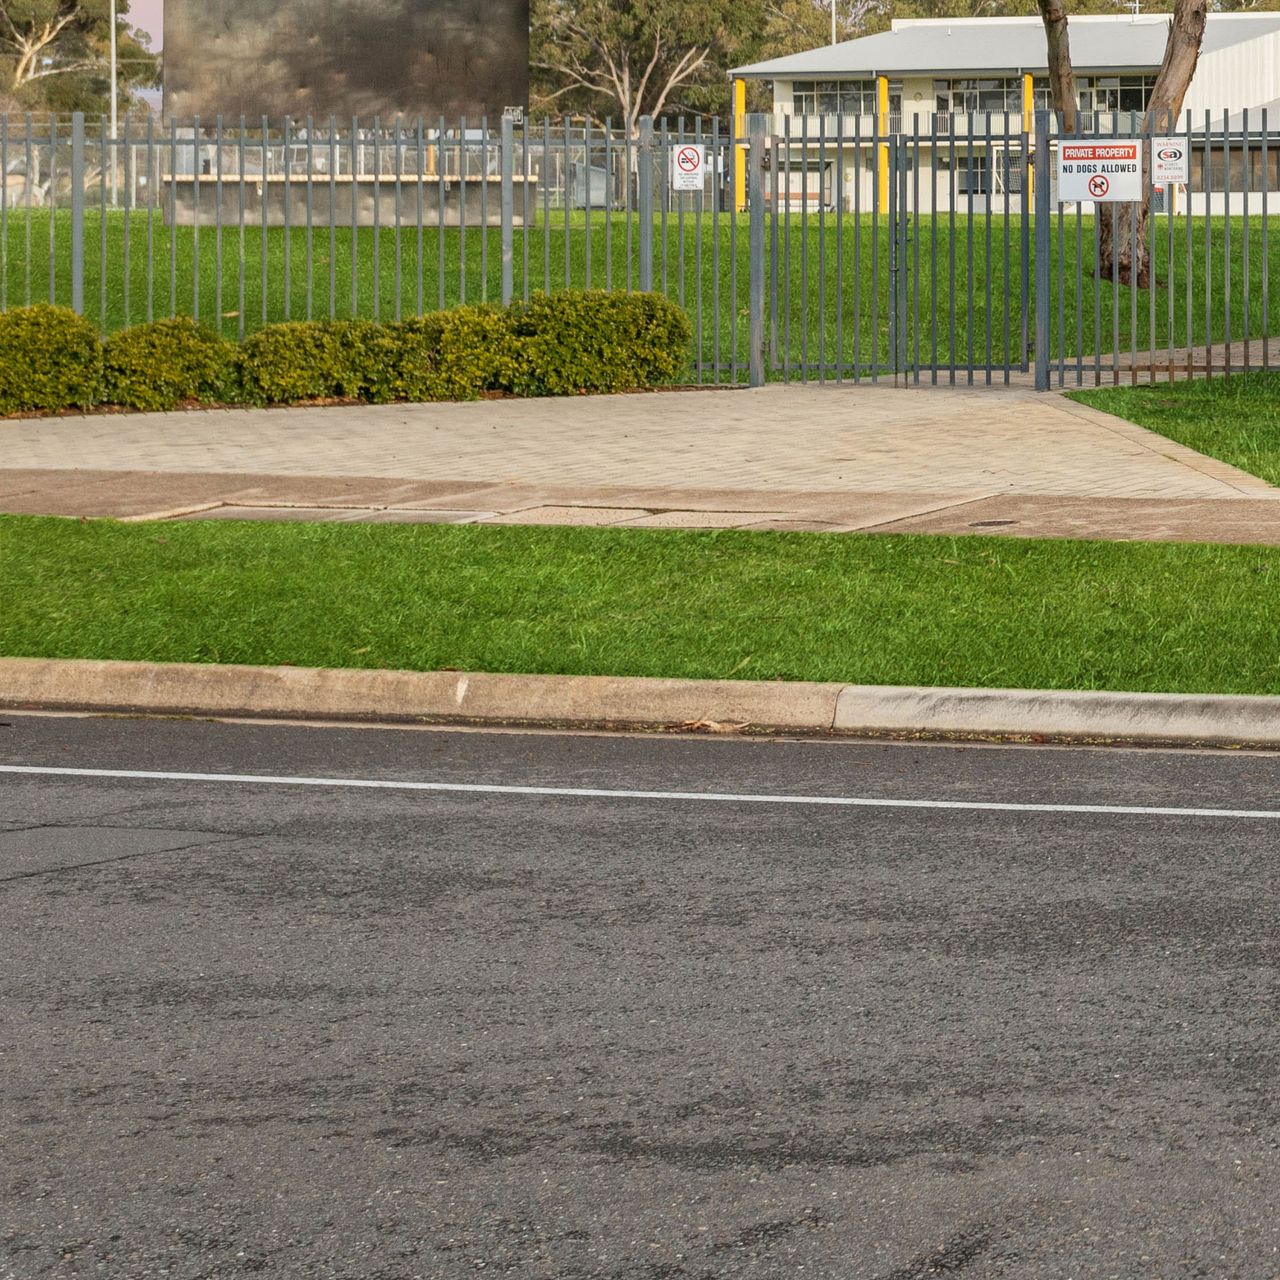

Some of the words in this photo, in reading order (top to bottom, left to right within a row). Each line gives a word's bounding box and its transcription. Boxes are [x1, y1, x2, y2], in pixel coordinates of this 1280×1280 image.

[1065, 149, 1094, 158] PRIVATE
[1095, 148, 1134, 157] PROPERTY
[1063, 164, 1073, 173] NO
[1077, 164, 1098, 173] DOGS
[1101, 164, 1137, 173] ALLOWED
